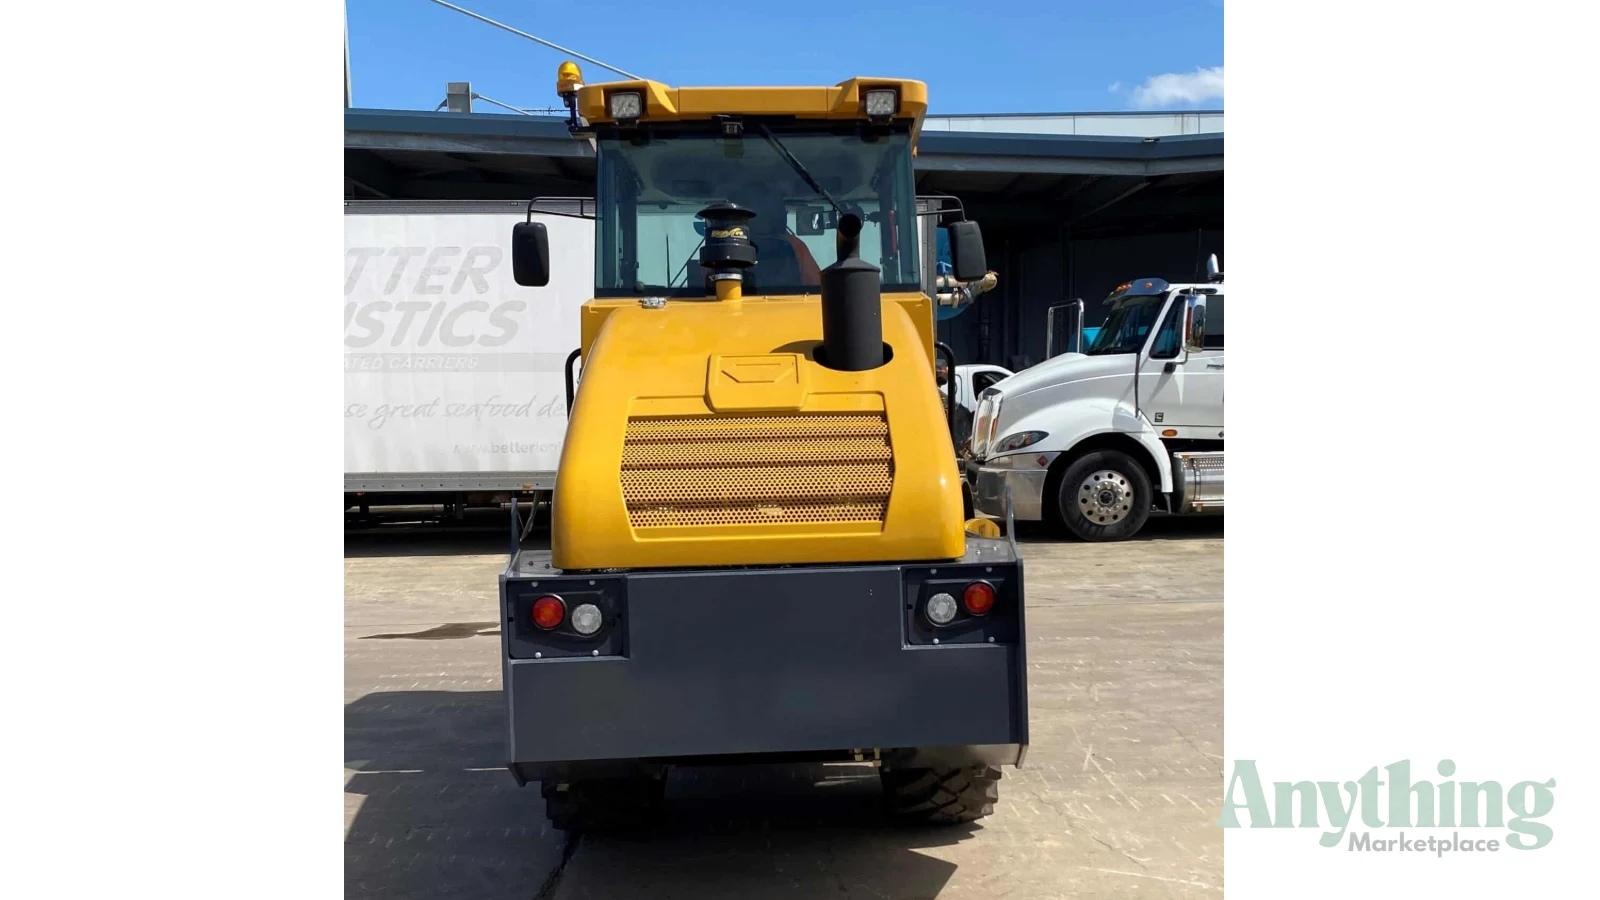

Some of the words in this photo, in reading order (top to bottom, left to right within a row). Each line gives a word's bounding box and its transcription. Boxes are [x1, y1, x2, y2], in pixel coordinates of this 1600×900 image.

[389, 356, 479, 370] CARRIERS
[368, 396, 441, 430] great
[442, 393, 537, 422] seafood
